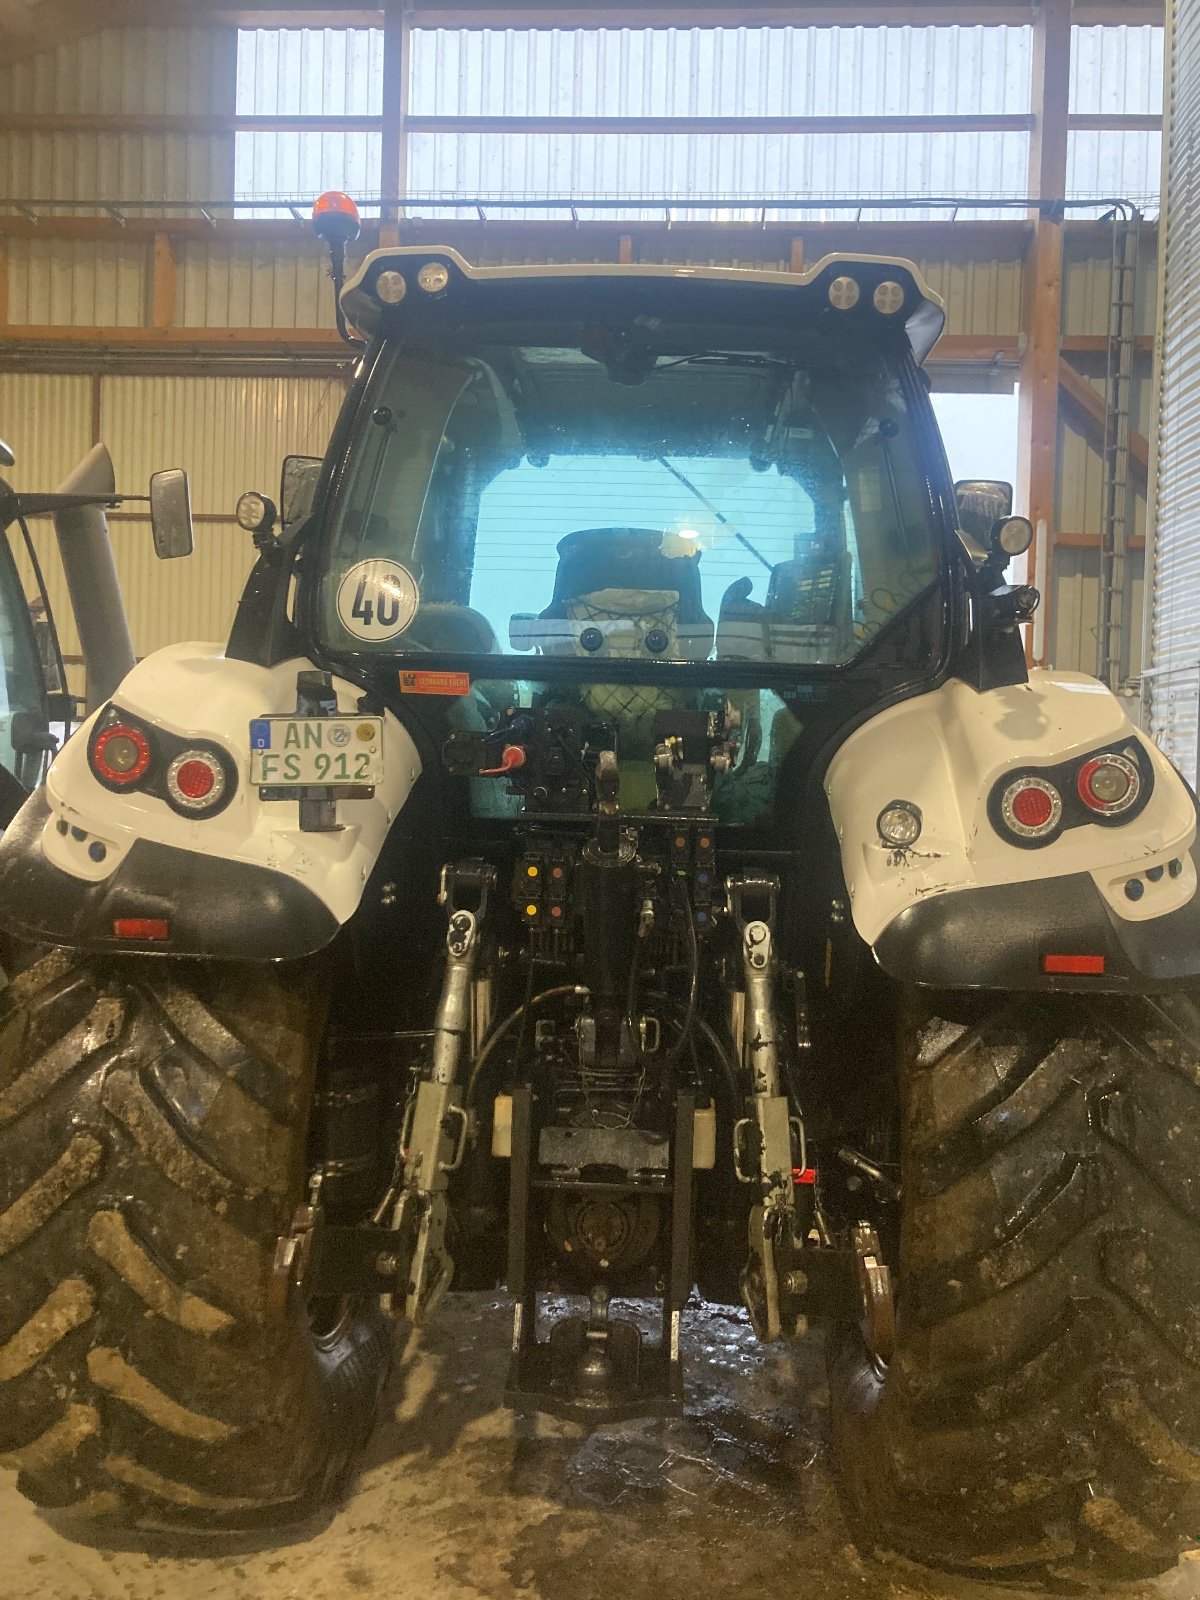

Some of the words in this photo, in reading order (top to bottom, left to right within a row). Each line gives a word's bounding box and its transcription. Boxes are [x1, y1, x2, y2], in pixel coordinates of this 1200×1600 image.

[352, 574, 401, 626] 40
[258, 739, 265, 748] D
[284, 722, 322, 749] AN
[262, 753, 301, 780] FS
[314, 752, 370, 780] 912
